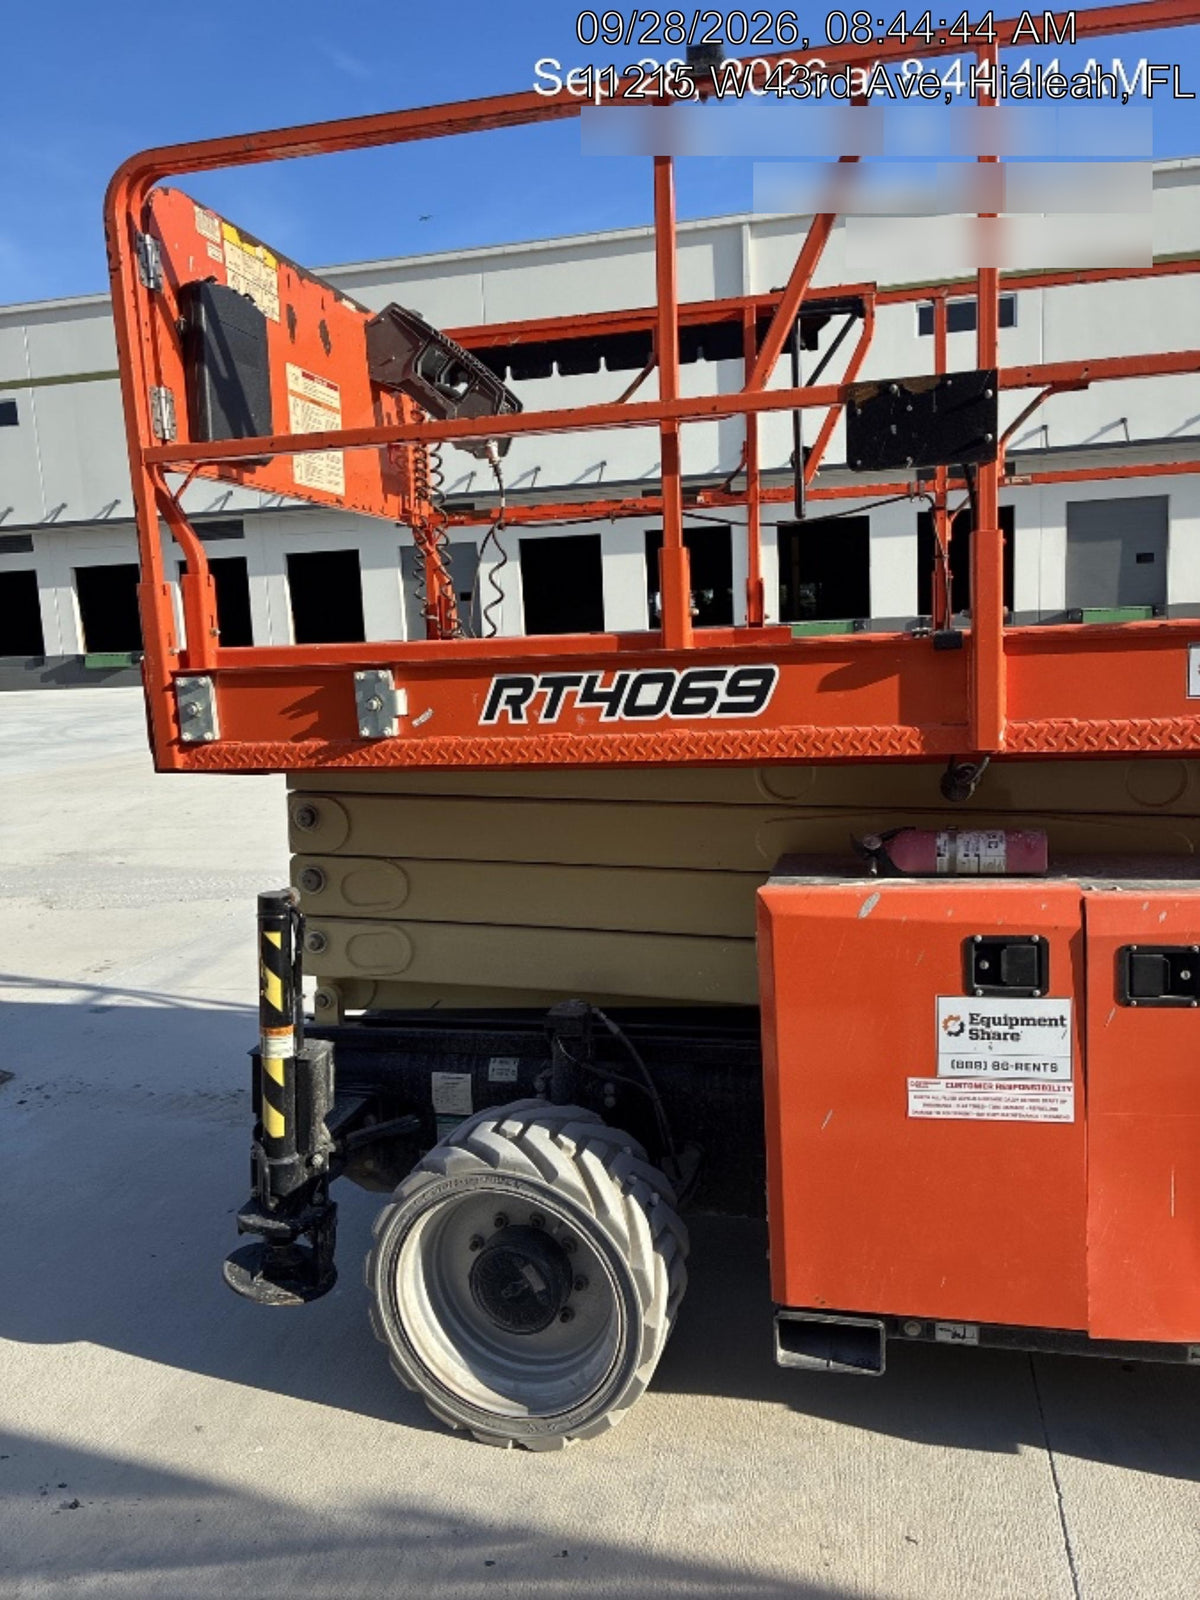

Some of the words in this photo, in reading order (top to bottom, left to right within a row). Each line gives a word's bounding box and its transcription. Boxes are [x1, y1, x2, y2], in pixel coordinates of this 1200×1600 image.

[478, 664, 780, 725] RT4069
[968, 1012, 1068, 1029] Equipment
[968, 1028, 1021, 1042] Share
